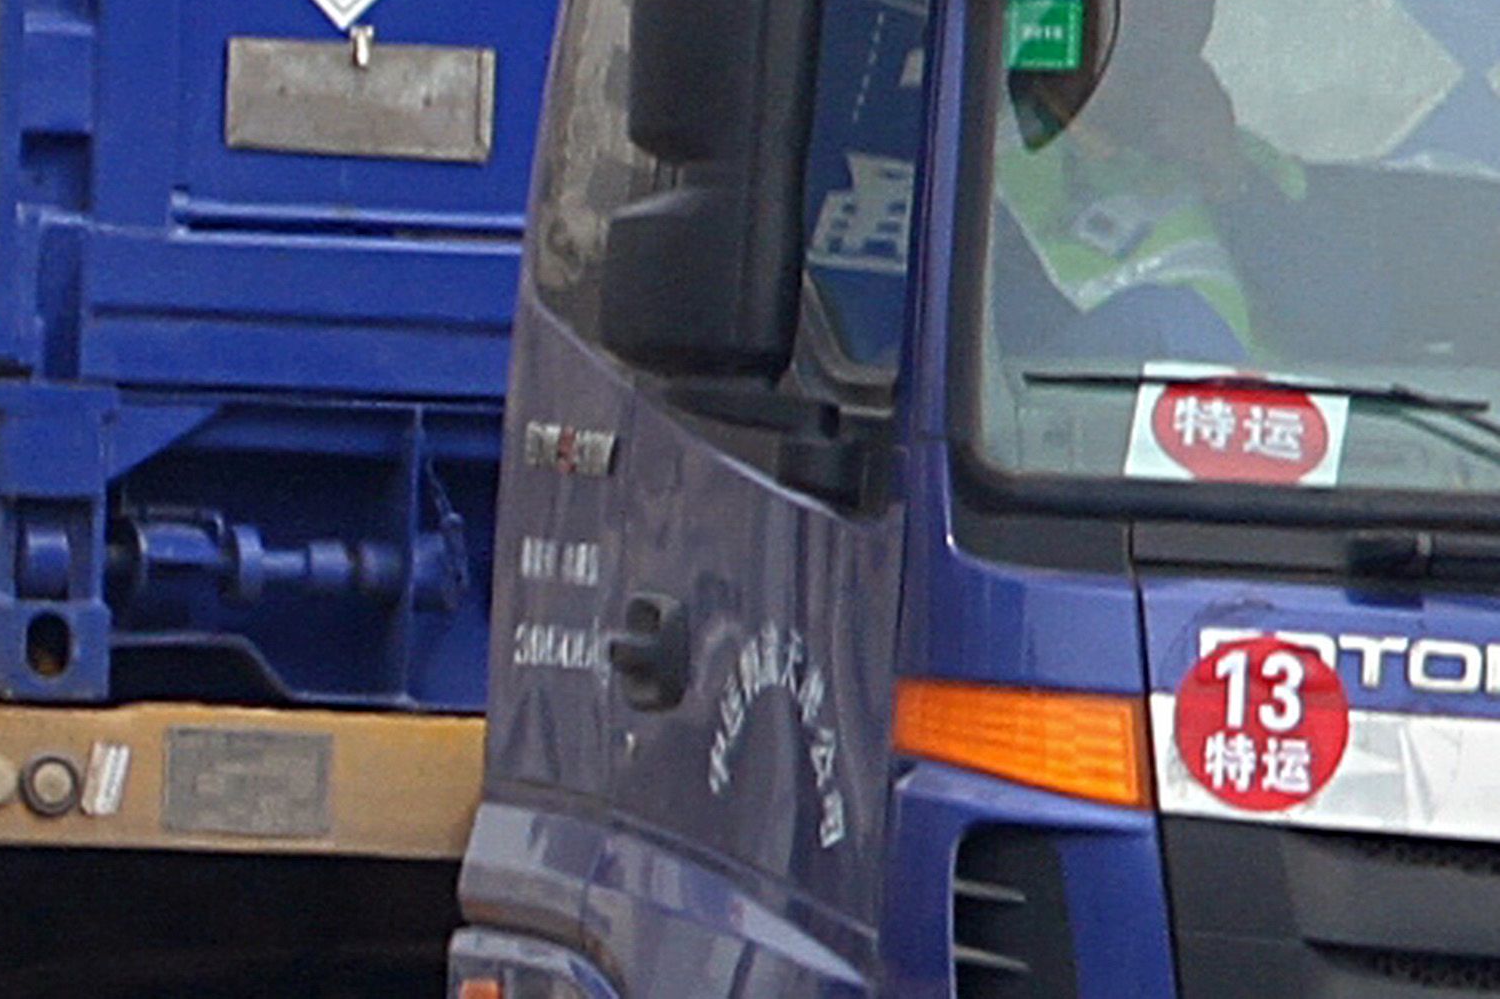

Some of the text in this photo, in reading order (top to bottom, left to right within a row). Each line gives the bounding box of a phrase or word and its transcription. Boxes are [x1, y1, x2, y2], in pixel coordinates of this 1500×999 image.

[1173, 395, 1304, 460] 特运
[1215, 650, 1305, 732] 13
[1204, 731, 1312, 793] 特运
